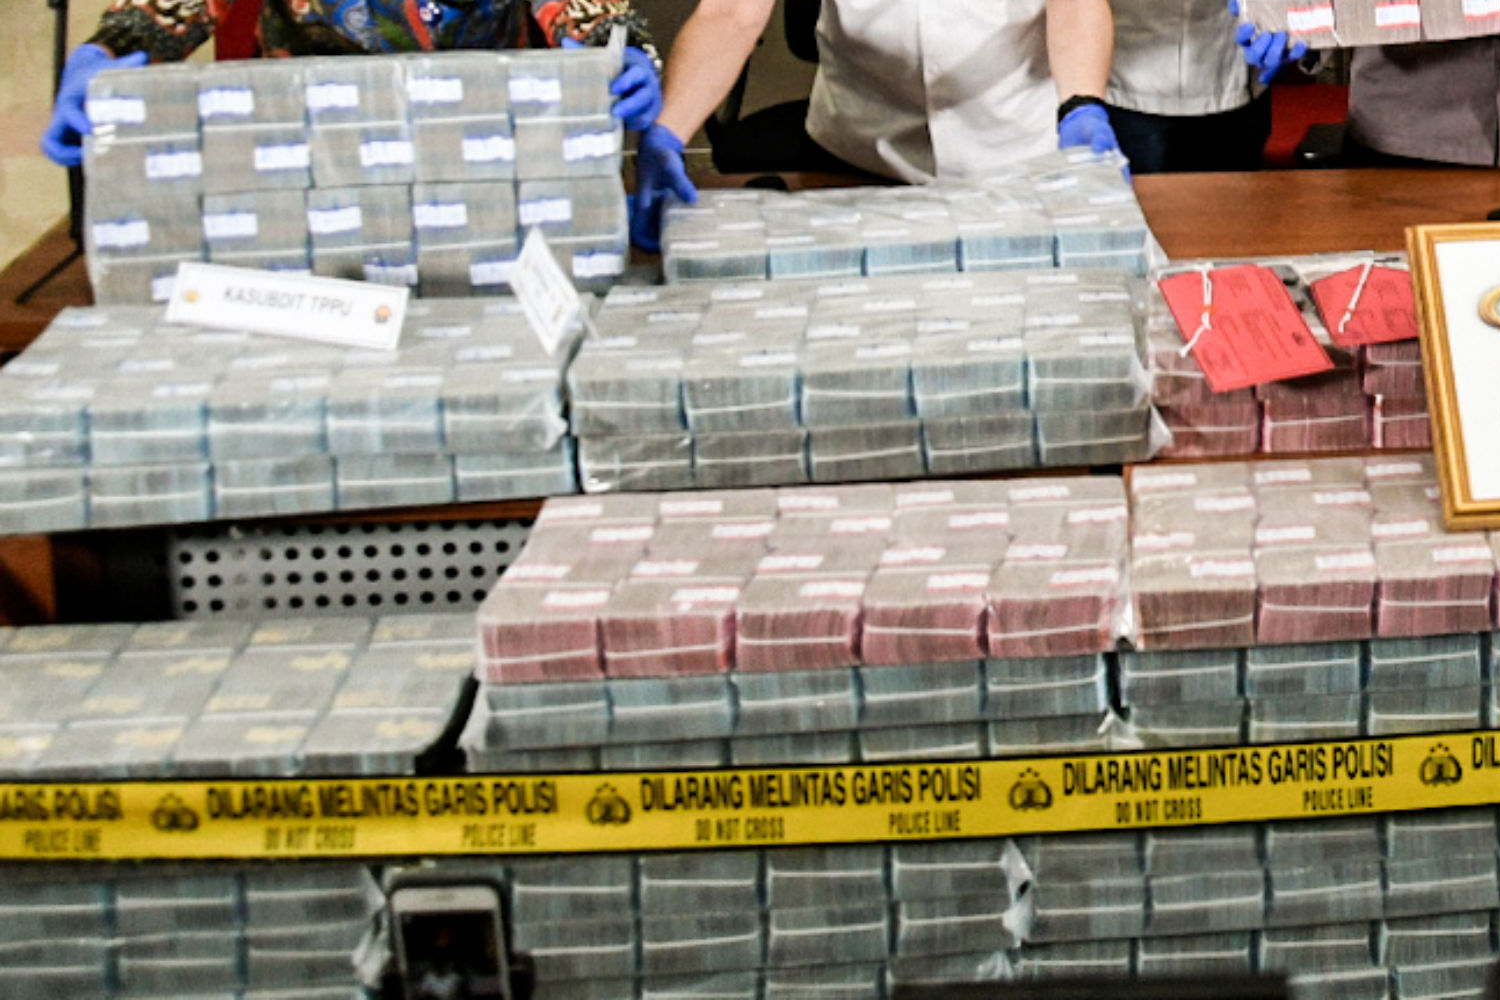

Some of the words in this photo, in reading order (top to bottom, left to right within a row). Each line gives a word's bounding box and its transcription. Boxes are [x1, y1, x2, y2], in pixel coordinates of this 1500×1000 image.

[310, 295, 354, 316] TPPU
[1062, 758, 1161, 796] DILARANG
[1168, 750, 1263, 789] MELINTAS
[1268, 746, 1326, 784] GARIS
[1332, 744, 1394, 780] POLISI
[206, 786, 316, 819] DILARANG
[320, 784, 419, 818] MELINTAS
[424, 782, 489, 816] GARIS
[492, 781, 558, 815] POLISI
[640, 776, 744, 811] DILARANG
[749, 772, 845, 808] MELINTAS
[851, 770, 912, 804] GARIS
[919, 766, 982, 802] POLISI
[1303, 789, 1344, 811] POLICE
[1348, 786, 1373, 809] LINE
[888, 812, 929, 835] POLICE
[934, 810, 961, 833] LINE
[1115, 801, 1130, 824] DO
[1135, 800, 1159, 822] NOT
[1164, 797, 1202, 821] CROSS
[462, 824, 504, 846] POLICE
[509, 823, 536, 846] LINE
[695, 818, 712, 842] DO
[716, 817, 740, 841] NOT
[745, 816, 785, 840] CROSS
